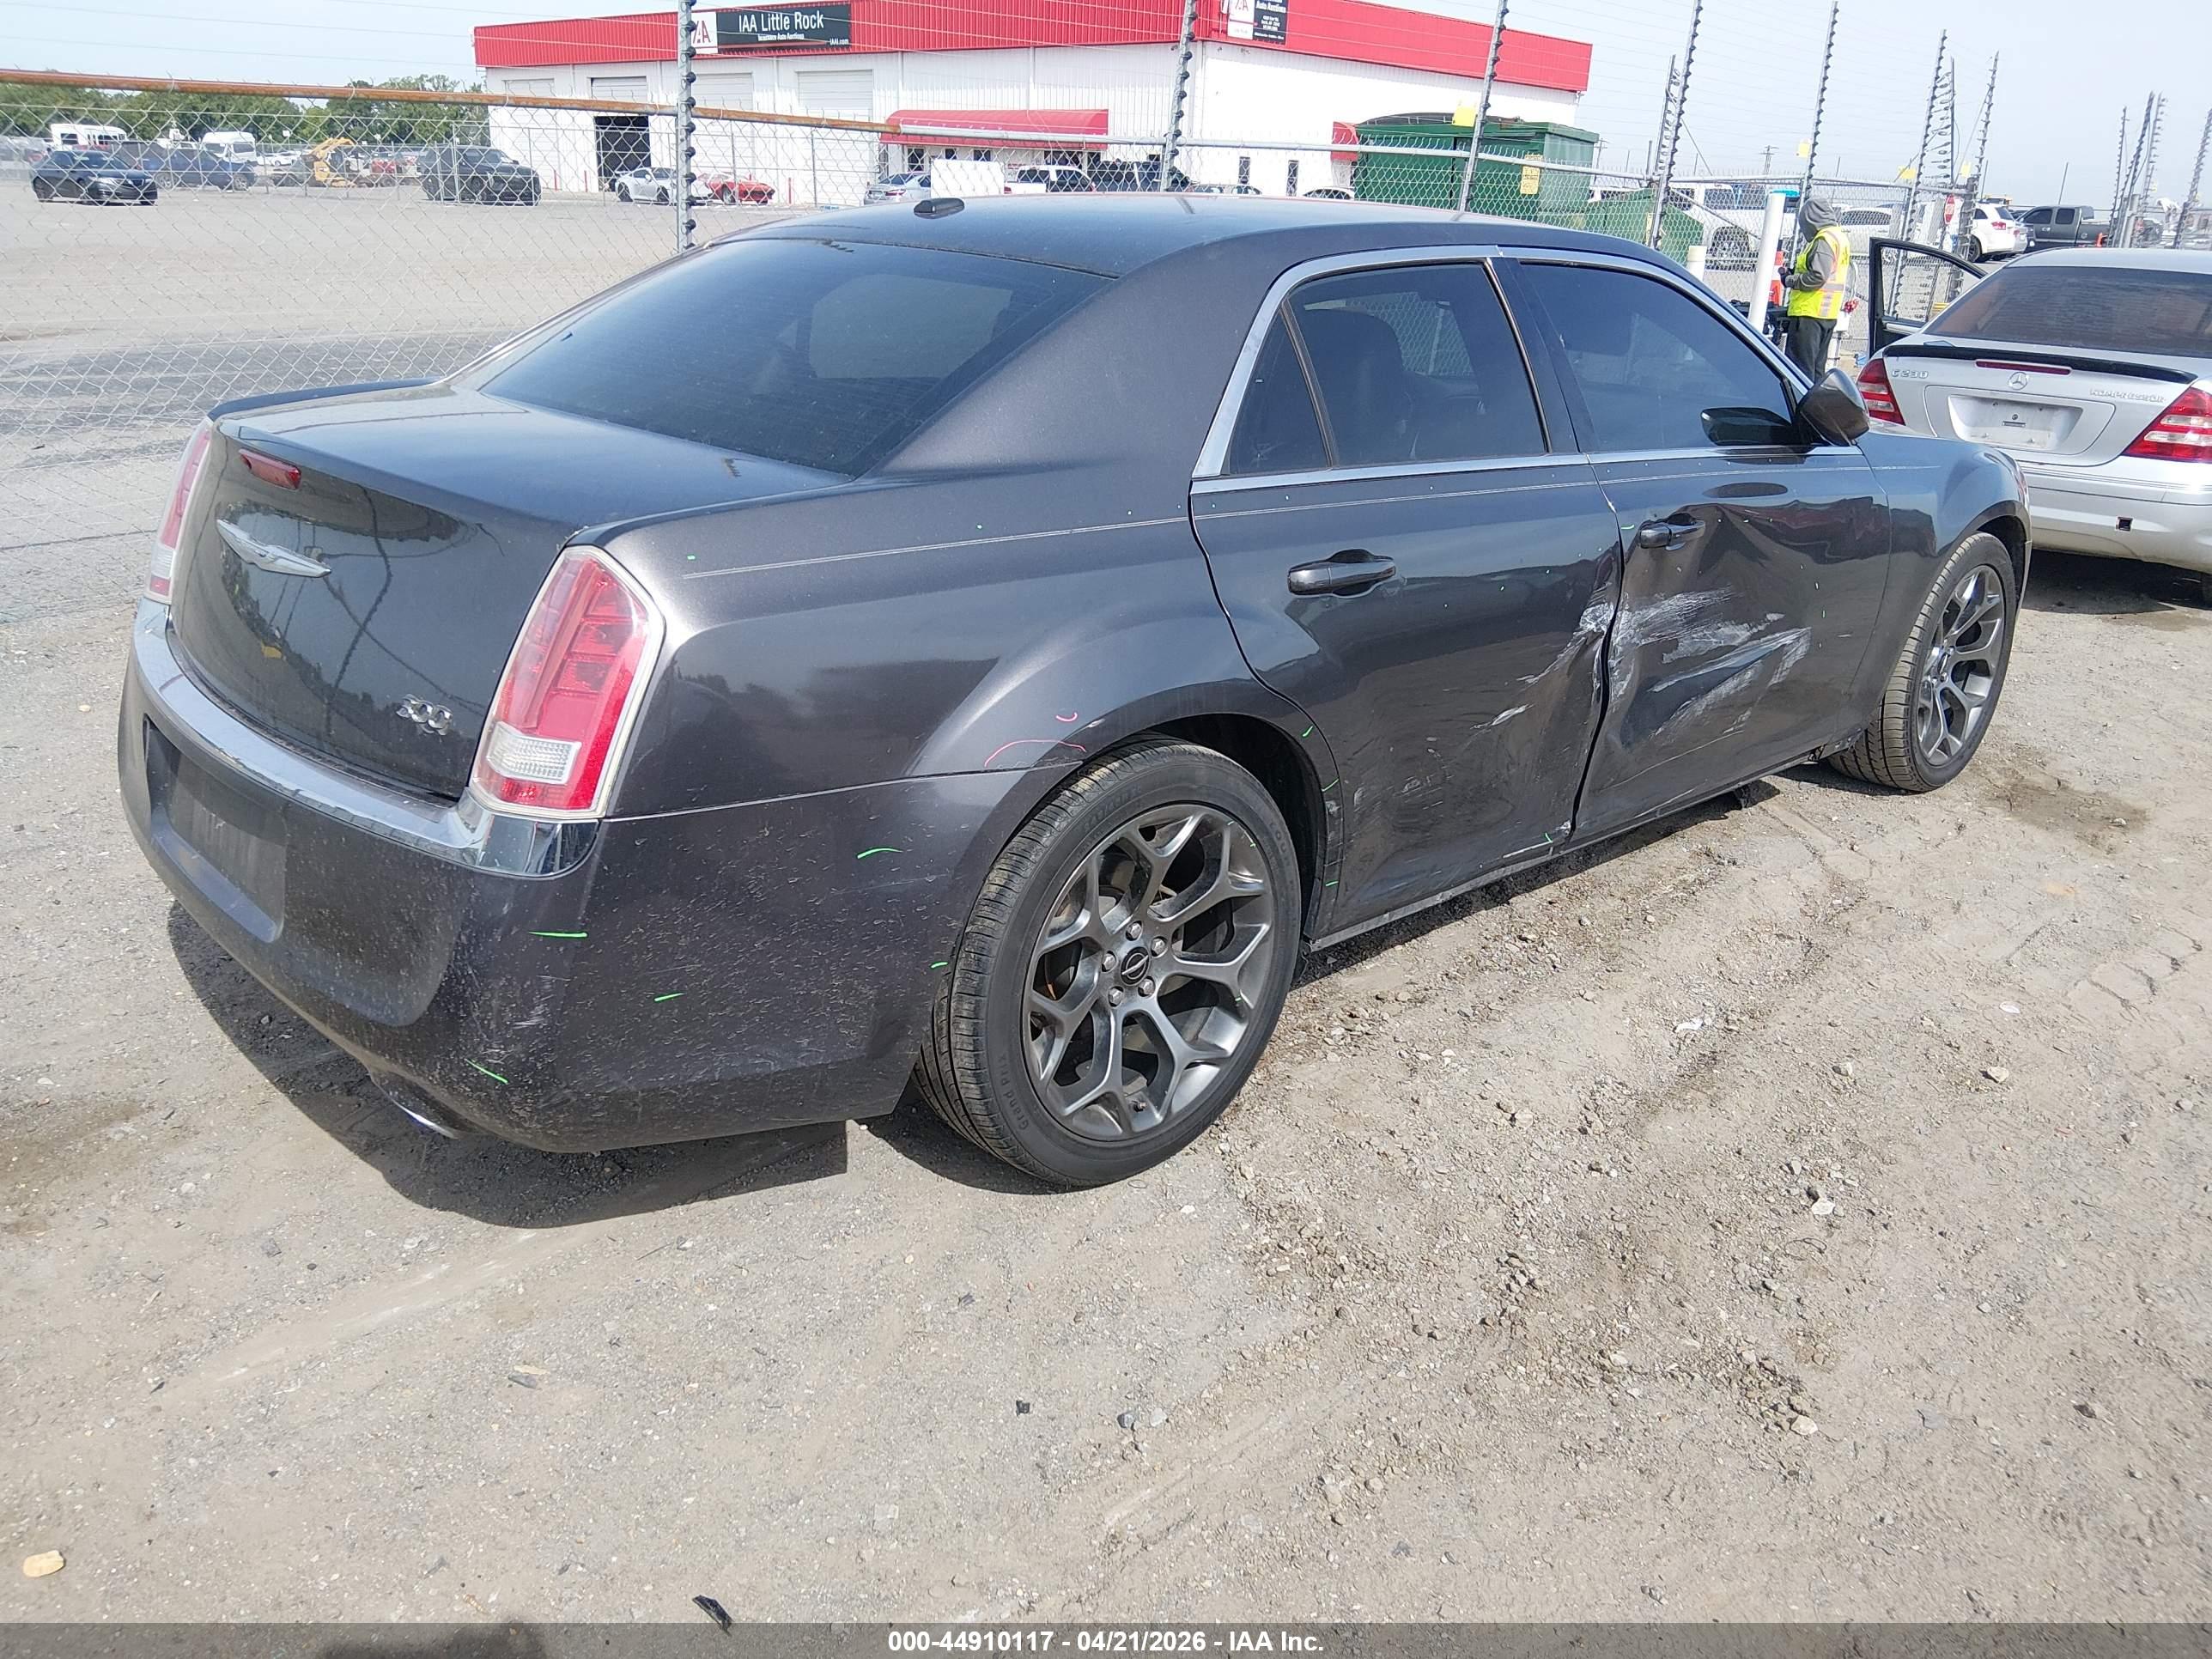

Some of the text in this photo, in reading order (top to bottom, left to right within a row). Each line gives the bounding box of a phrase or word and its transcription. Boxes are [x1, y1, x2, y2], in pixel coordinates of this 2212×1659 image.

[738, 10, 824, 33] IAA Little Rock
